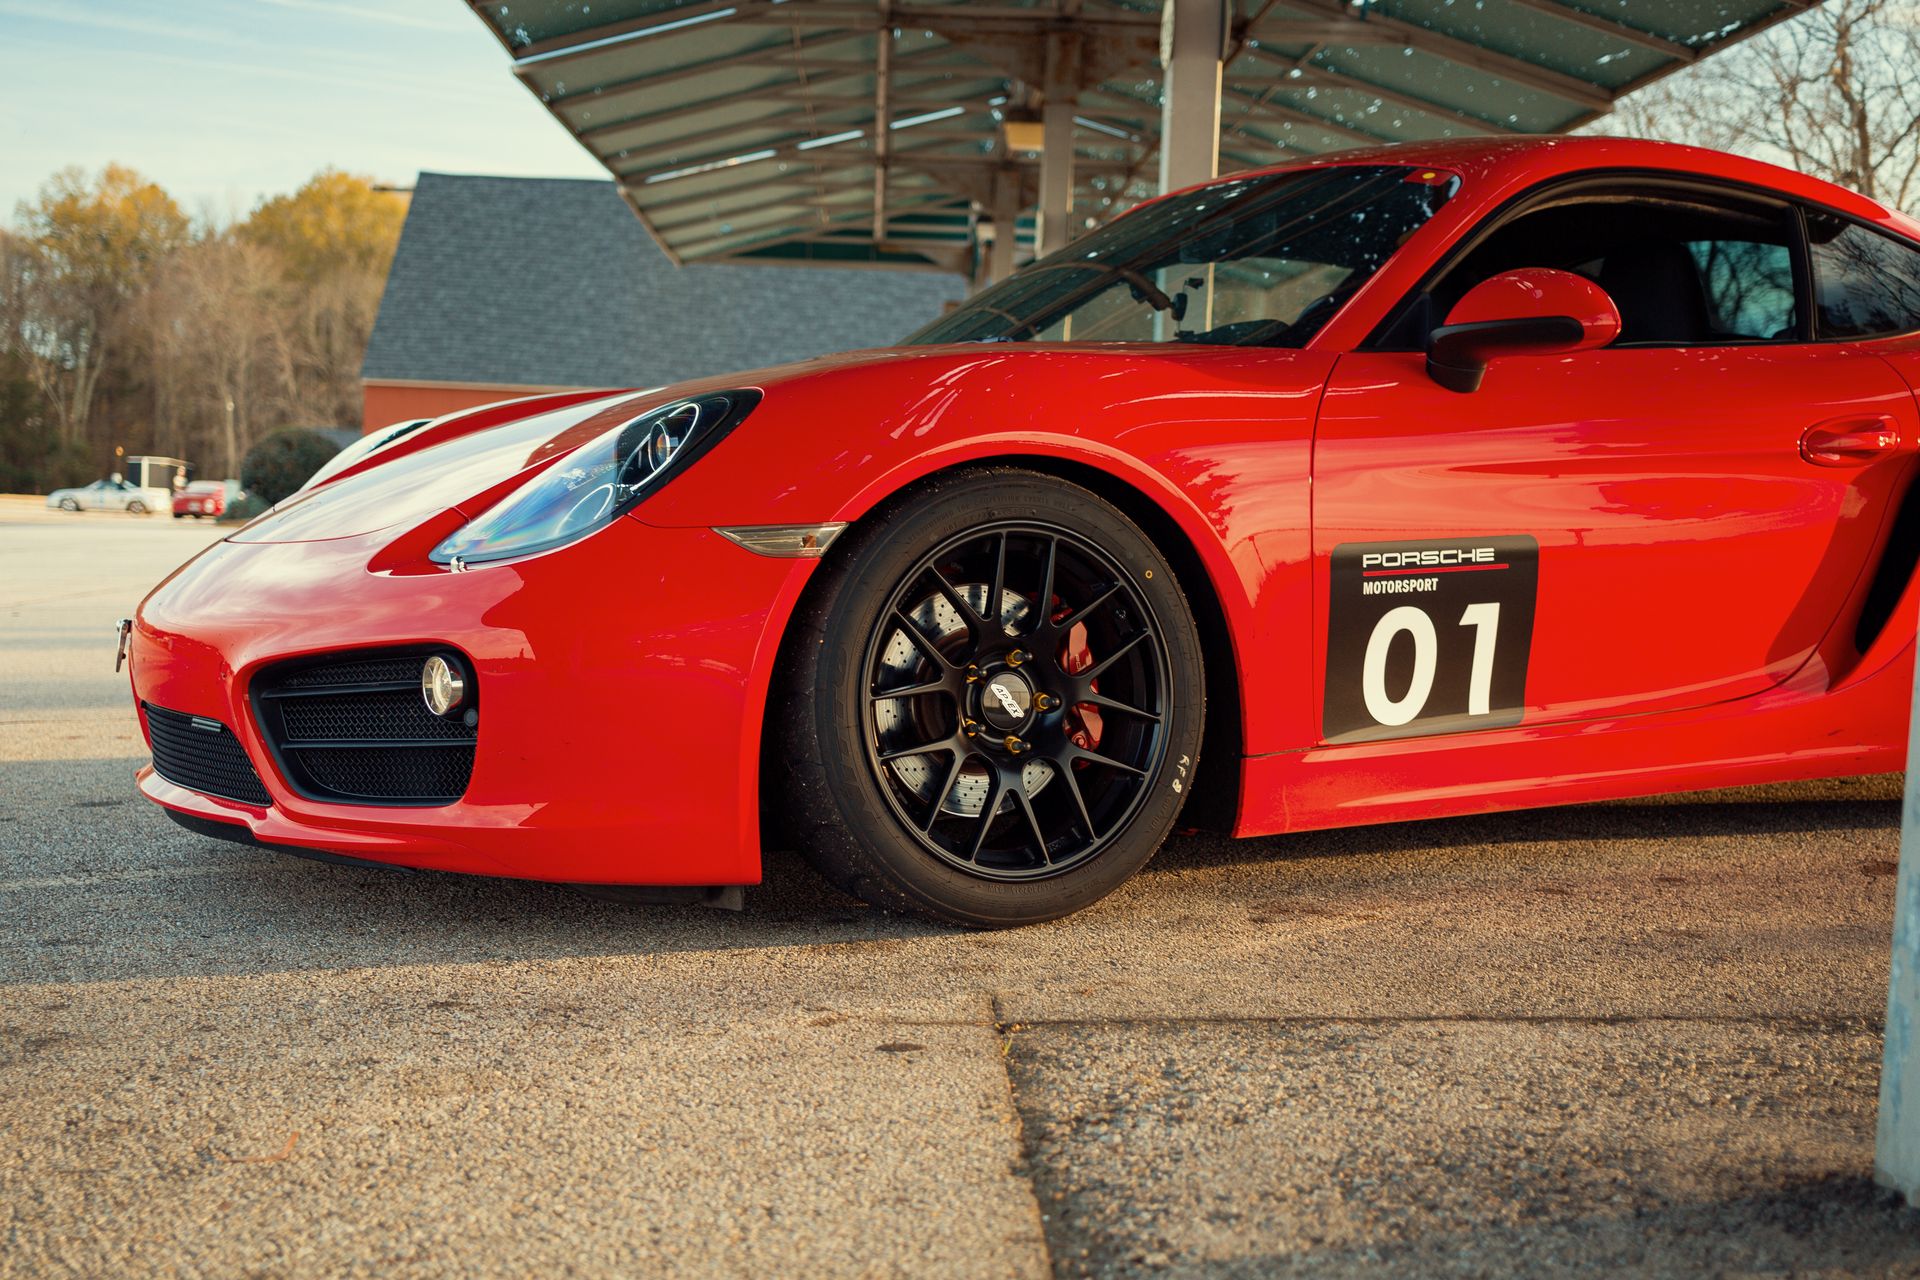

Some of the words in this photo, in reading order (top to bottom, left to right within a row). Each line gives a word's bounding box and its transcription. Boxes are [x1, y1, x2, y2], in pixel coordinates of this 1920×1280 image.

[1362, 547, 1495, 568] PORSCHE
[1363, 577, 1439, 595] MOTORSPORT
[1362, 601, 1501, 727] 01
[994, 685, 1022, 716] APEX
